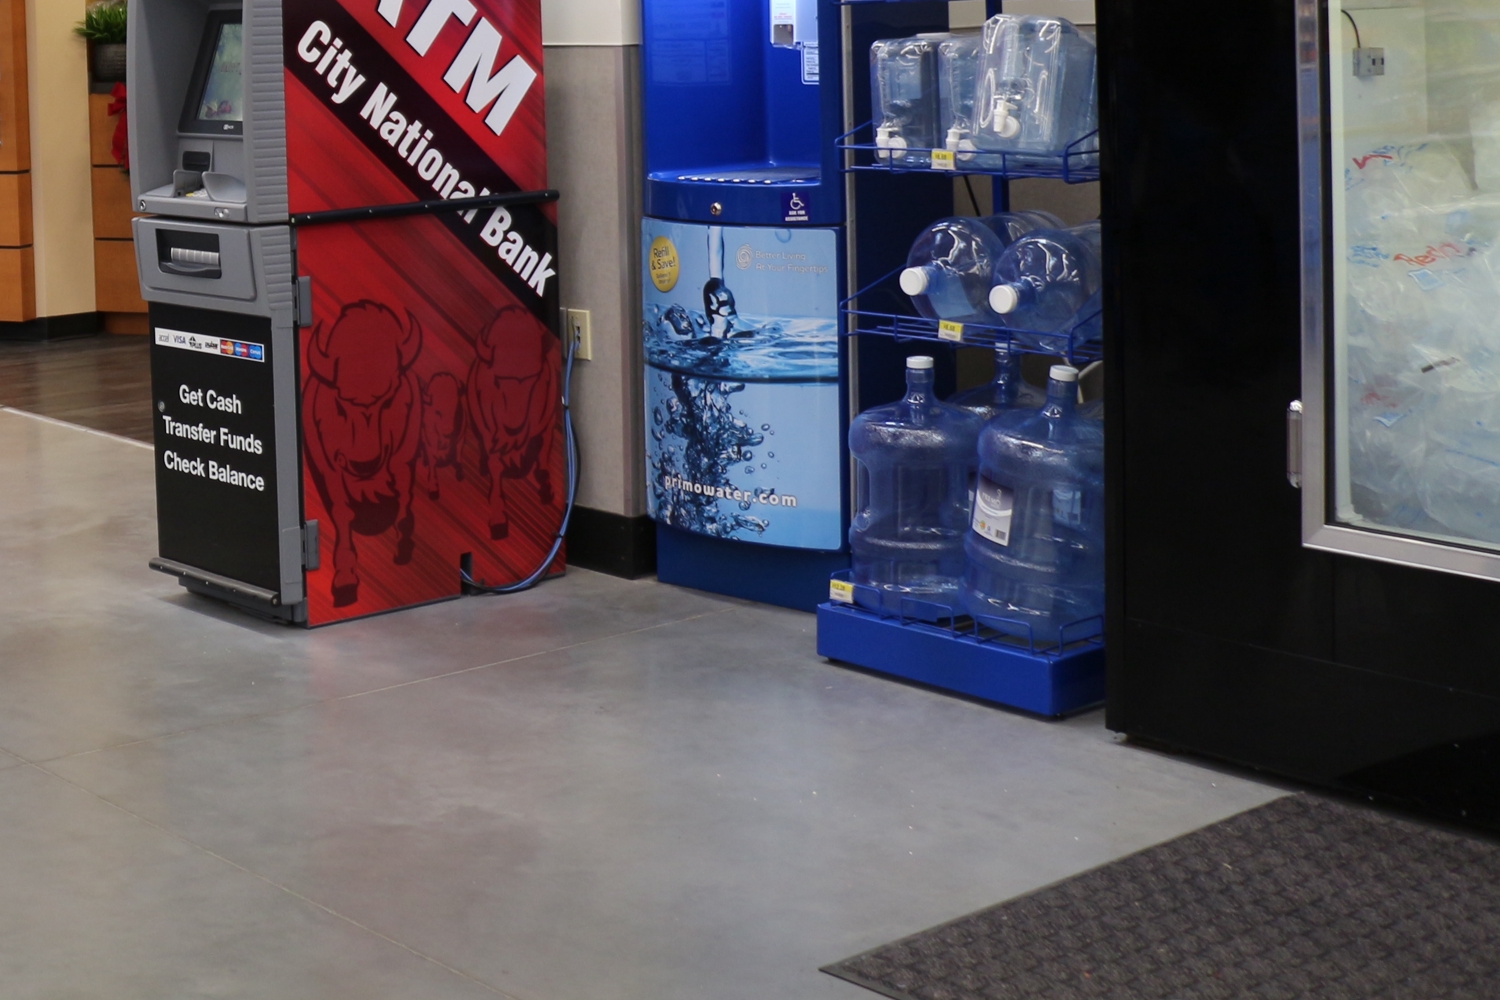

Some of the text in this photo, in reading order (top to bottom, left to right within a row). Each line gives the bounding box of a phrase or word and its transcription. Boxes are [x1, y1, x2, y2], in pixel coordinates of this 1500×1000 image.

[297, 20, 366, 105] City
[479, 201, 556, 298] Bank
[653, 245, 670, 259] Refill
[755, 250, 807, 262] Better Living
[657, 257, 676, 270] Save!
[755, 263, 828, 274] At Your Fingertips
[173, 335, 186, 345] VISA
[179, 384, 242, 414] Get Cash
[162, 415, 263, 455] Transfer Funds
[163, 450, 265, 492] Check Balance
[664, 475, 798, 507] primowater.com
